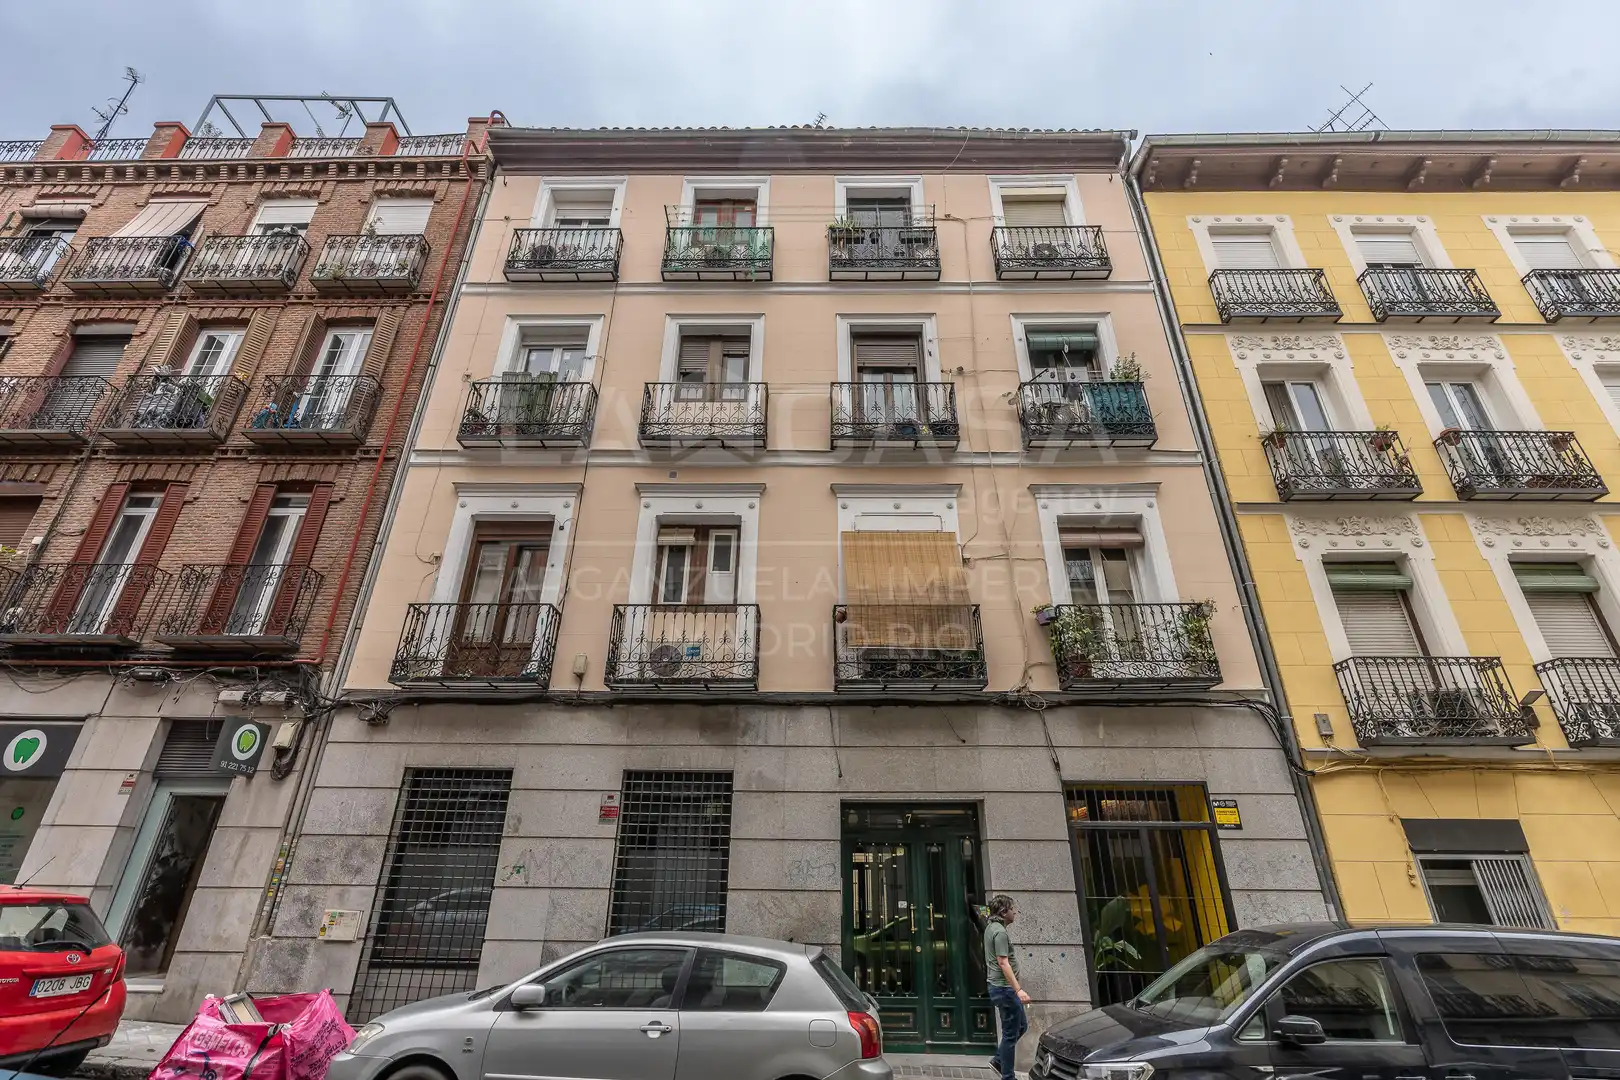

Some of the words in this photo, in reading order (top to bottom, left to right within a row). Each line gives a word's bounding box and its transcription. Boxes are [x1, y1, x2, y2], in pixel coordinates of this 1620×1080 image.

[906, 813, 912, 824] 7
[38, 979, 66, 993] 0208
[70, 976, 90, 990] JBG
